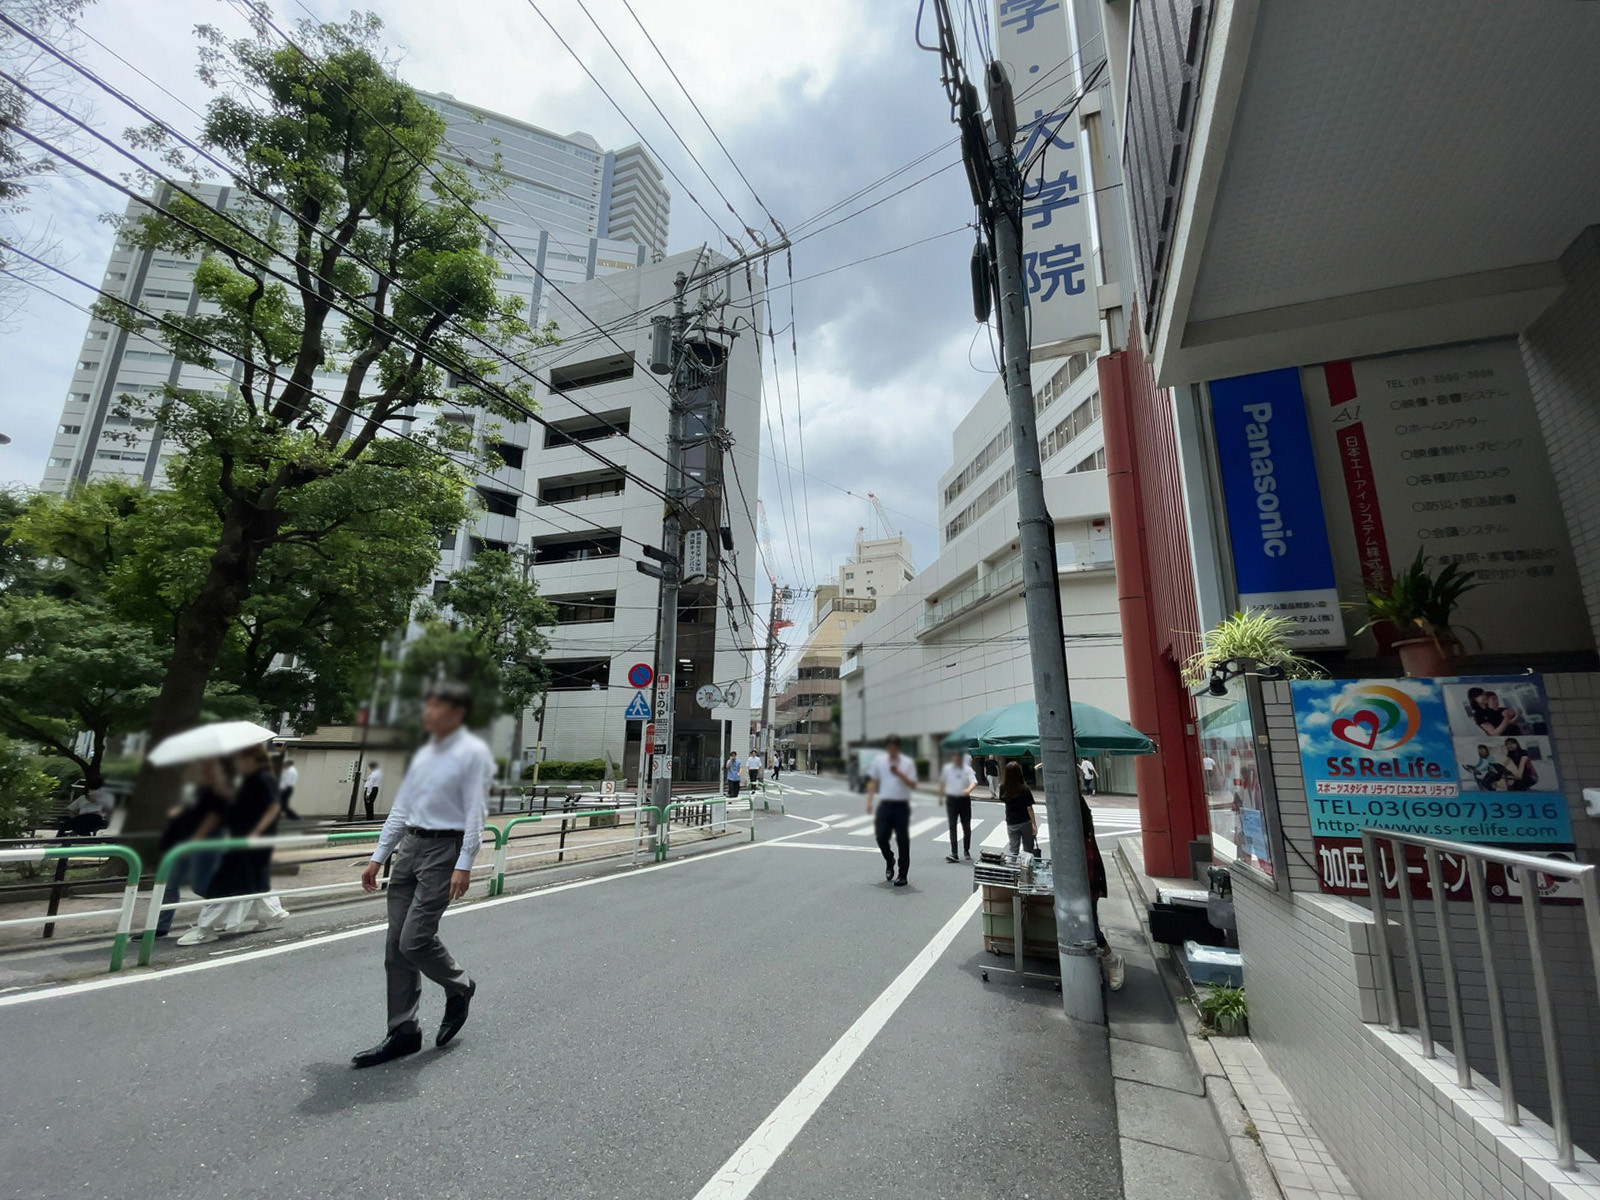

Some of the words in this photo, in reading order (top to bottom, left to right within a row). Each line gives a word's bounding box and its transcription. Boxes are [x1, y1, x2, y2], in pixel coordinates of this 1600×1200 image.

[1242, 401, 1293, 558] Panasonic
[1317, 783, 1369, 793] スポーツスタジオ
[1371, 784, 1397, 795] リライフ
